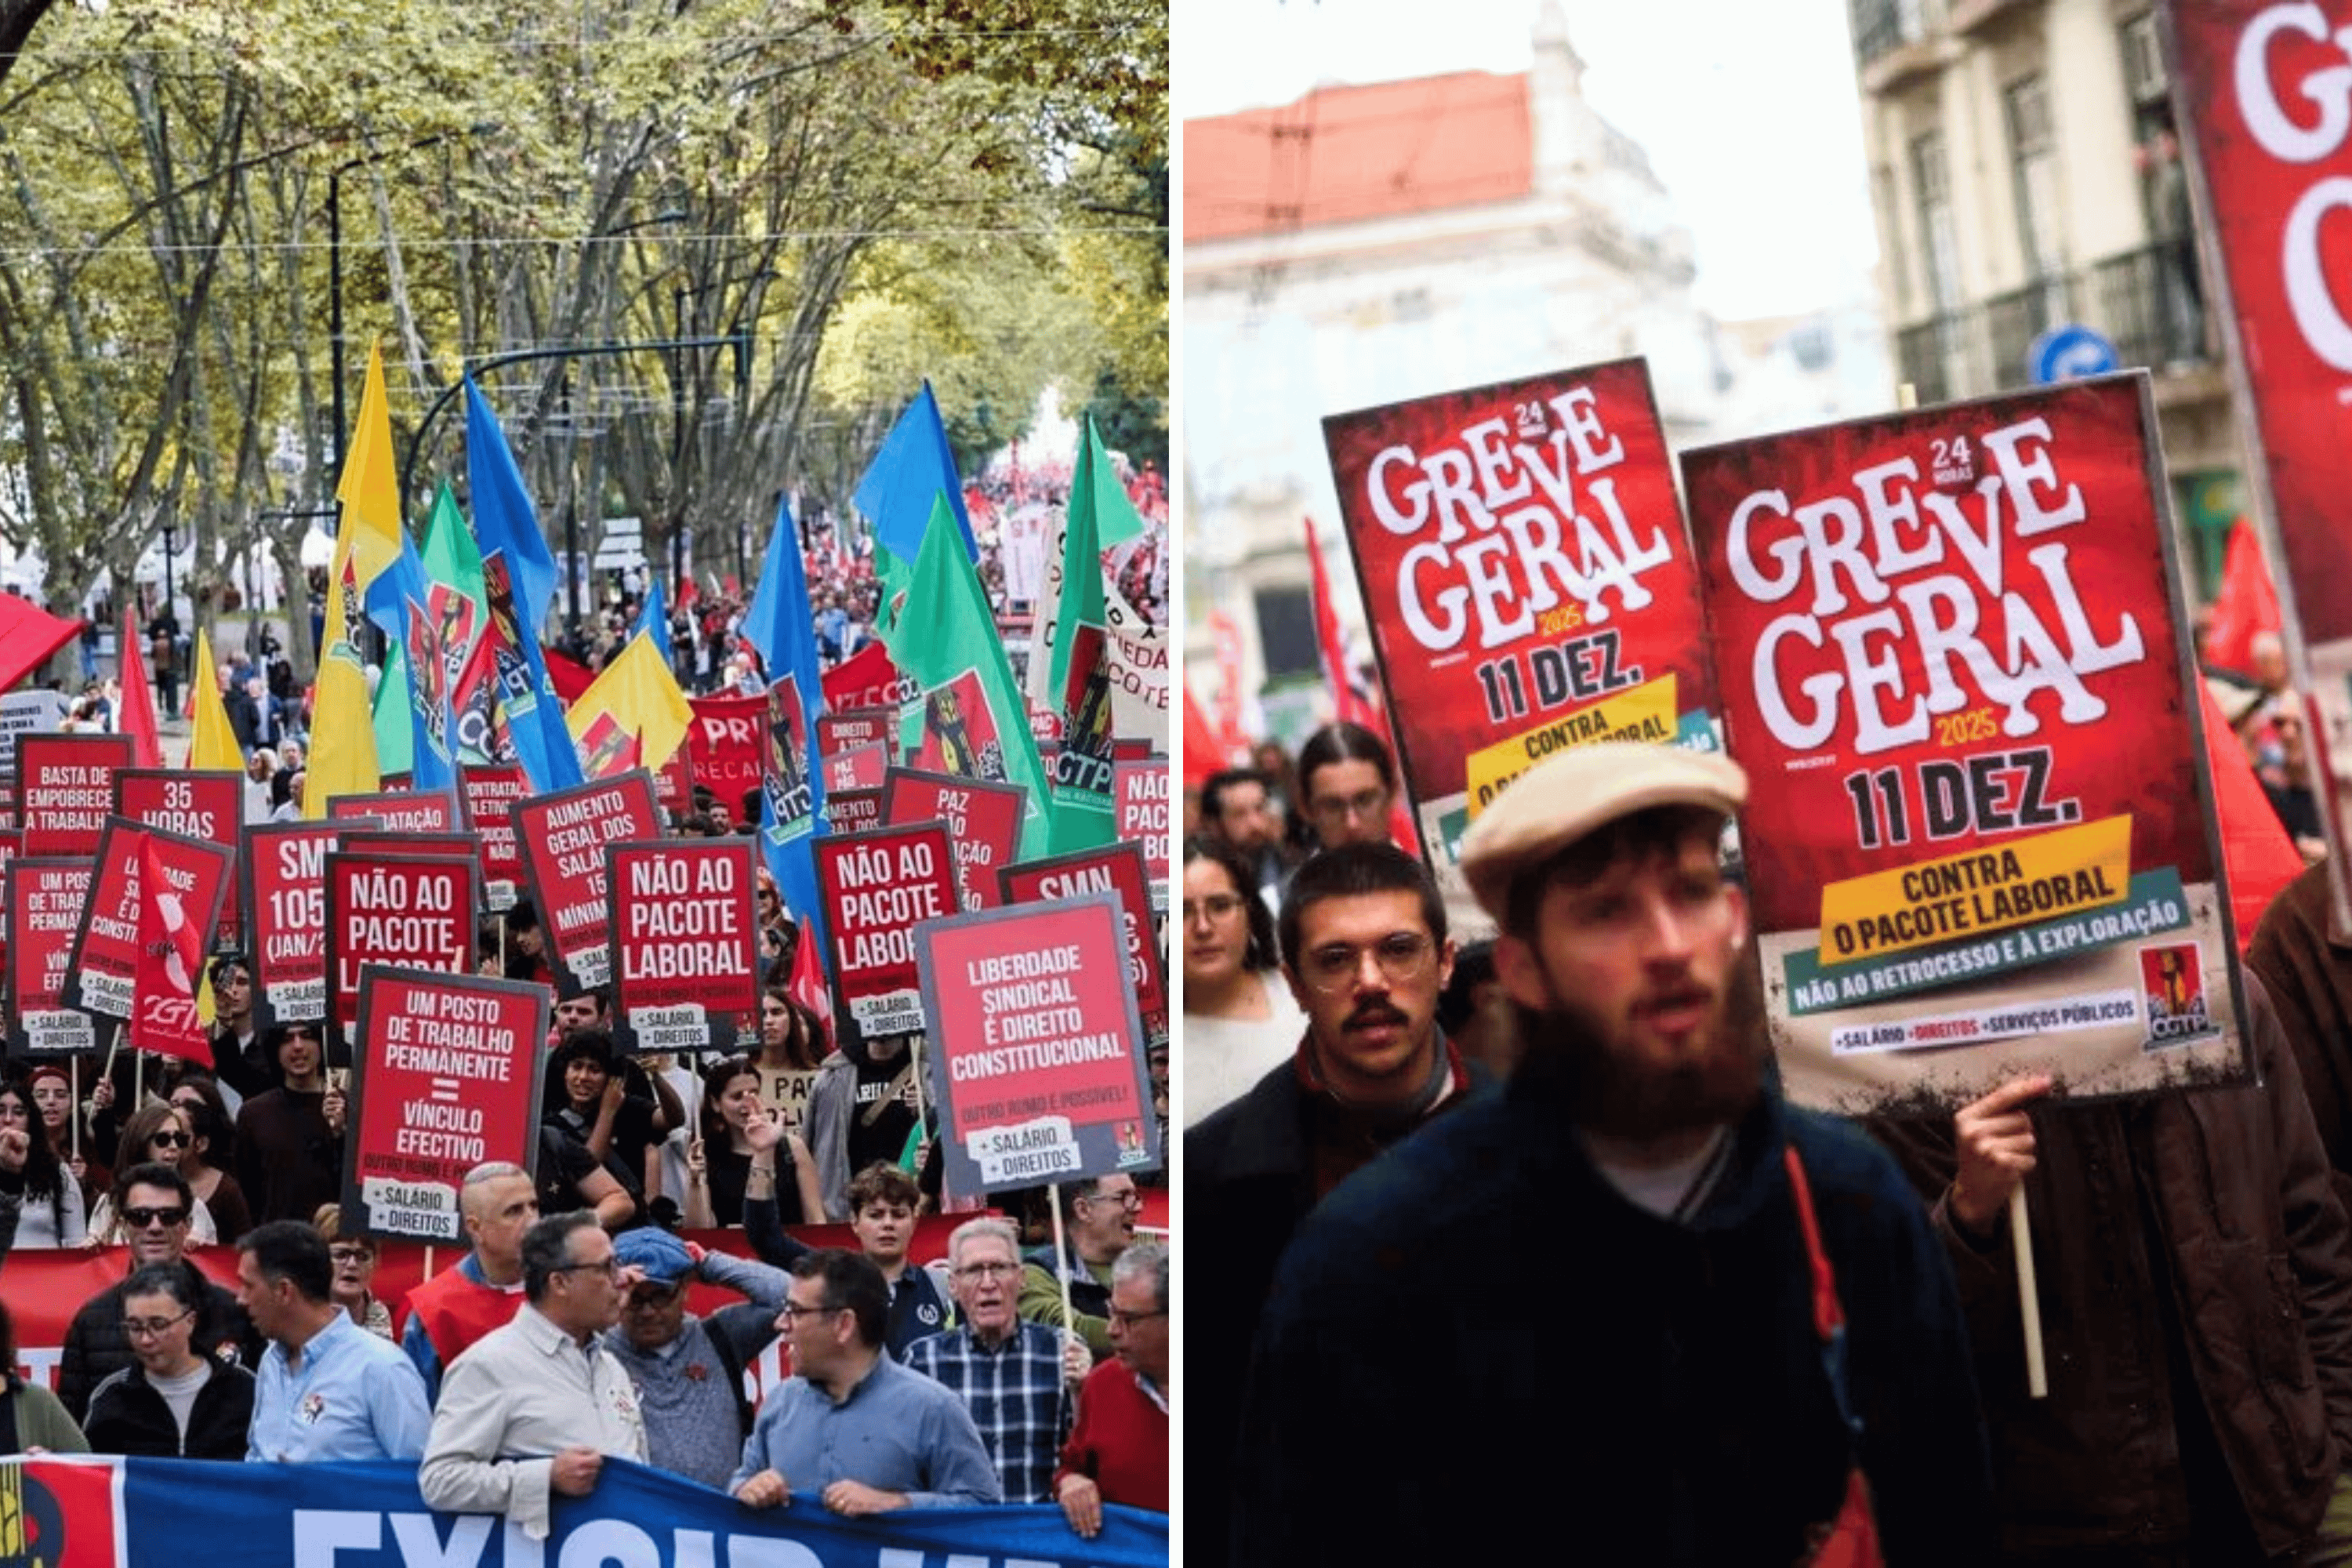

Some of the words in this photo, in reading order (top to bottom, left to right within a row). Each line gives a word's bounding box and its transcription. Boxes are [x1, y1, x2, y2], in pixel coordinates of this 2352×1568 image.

[1514, 401, 1544, 426] 24
[1367, 386, 1624, 544] GREVE
[1930, 436, 1971, 468] 24
[1727, 416, 2086, 617] GREVE
[1396, 477, 1672, 651] GERAL
[1537, 604, 1581, 637] 2025
[1753, 543, 2145, 754] GERAL
[1477, 655, 1528, 724] 11
[1533, 630, 1642, 710] DEZ.
[1524, 710, 1609, 760] CONTRA
[1936, 707, 1998, 748] 2025
[41, 766, 88, 786] BASTA
[92, 765, 110, 785] DE
[26, 789, 113, 808] EMPOBRECE
[164, 781, 193, 808] 35
[546, 790, 625, 831] AUMENTO
[937, 789, 971, 814] PAZ
[1845, 766, 1910, 850] 11
[1918, 745, 2082, 842] DEZ.
[25, 811, 35, 830] A
[40, 811, 107, 830] TRABALH
[143, 811, 214, 839] HORAS
[547, 825, 601, 855] GERAL
[601, 814, 636, 840] DOS
[557, 844, 606, 879] SALÁ
[631, 854, 688, 896] NÃO
[696, 857, 734, 894] AO
[836, 845, 893, 889] NÃO
[898, 842, 934, 880] AO
[1902, 848, 2024, 903] CONTRA
[41, 872, 62, 891] UM
[65, 872, 93, 891] POS
[350, 866, 407, 910] NÃO
[415, 874, 452, 911] AO
[586, 873, 608, 896] 15
[28, 892, 47, 912] DE
[49, 892, 85, 912] TRAB
[270, 889, 324, 929] 105
[556, 899, 609, 931] MÍNIM
[631, 898, 738, 938] PACOTE
[840, 884, 942, 930] PACOTE
[1833, 922, 1853, 955] O
[1862, 902, 1968, 949] PACOTE
[1977, 866, 2115, 925] LABORAL
[349, 916, 455, 954] PACOTE
[837, 932, 914, 972] LABO
[622, 939, 750, 980] LABORAL
[967, 944, 1083, 985] LIBERDADE
[1795, 976, 1838, 1009] NÃO
[1841, 973, 1868, 998] AO
[1873, 946, 1999, 993] RETROCESSO
[2003, 942, 2018, 960] E
[2040, 899, 2181, 953] EXPLORAÇÃO
[407, 989, 436, 1016] UM
[441, 993, 500, 1024] POSTO
[866, 996, 913, 1017] SALÁRIO
[982, 977, 1078, 1014] SINDICAL
[2062, 1000, 2135, 1023] PÚBLICOS
[387, 1015, 413, 1041] DE
[417, 1019, 514, 1054] TRABALHO
[647, 1010, 694, 1027] SALÁRIO
[654, 1029, 703, 1044] DIREITOS
[873, 1011, 921, 1033] DIREITOS
[983, 1013, 1000, 1045] É
[1003, 1007, 1083, 1042] DIREITO
[385, 1044, 512, 1082] PERMANENTE
[951, 1032, 1127, 1082] CONSTITUCIONAL
[404, 1098, 484, 1134] VÍNCULO
[396, 1128, 485, 1162] EFECTIVO
[992, 1127, 1058, 1153] SALÁRIO
[1002, 1149, 1072, 1175] DIREITOS
[383, 1185, 443, 1210] SALÁRIO
[388, 1210, 451, 1234] DIREITOS
